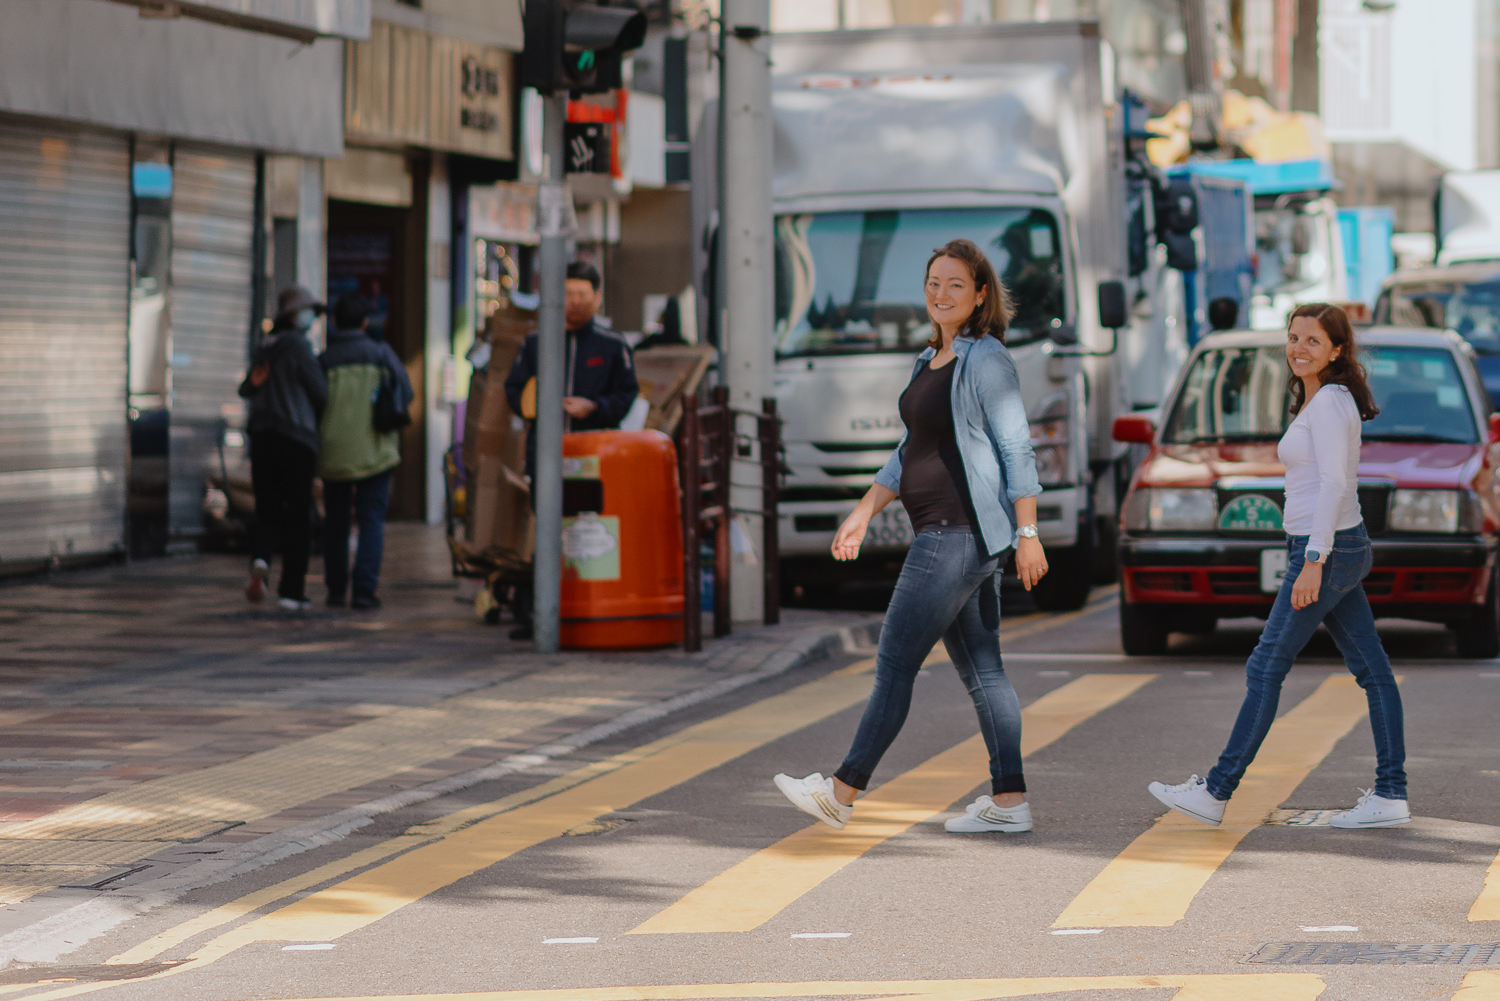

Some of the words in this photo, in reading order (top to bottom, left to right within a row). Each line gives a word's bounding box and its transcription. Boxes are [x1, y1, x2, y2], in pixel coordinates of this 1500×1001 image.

[850, 418, 906, 430] ISUZ
[1231, 498, 1271, 511] TAXI
[1246, 506, 1258, 520] 5
[1230, 519, 1274, 529] SEATS
